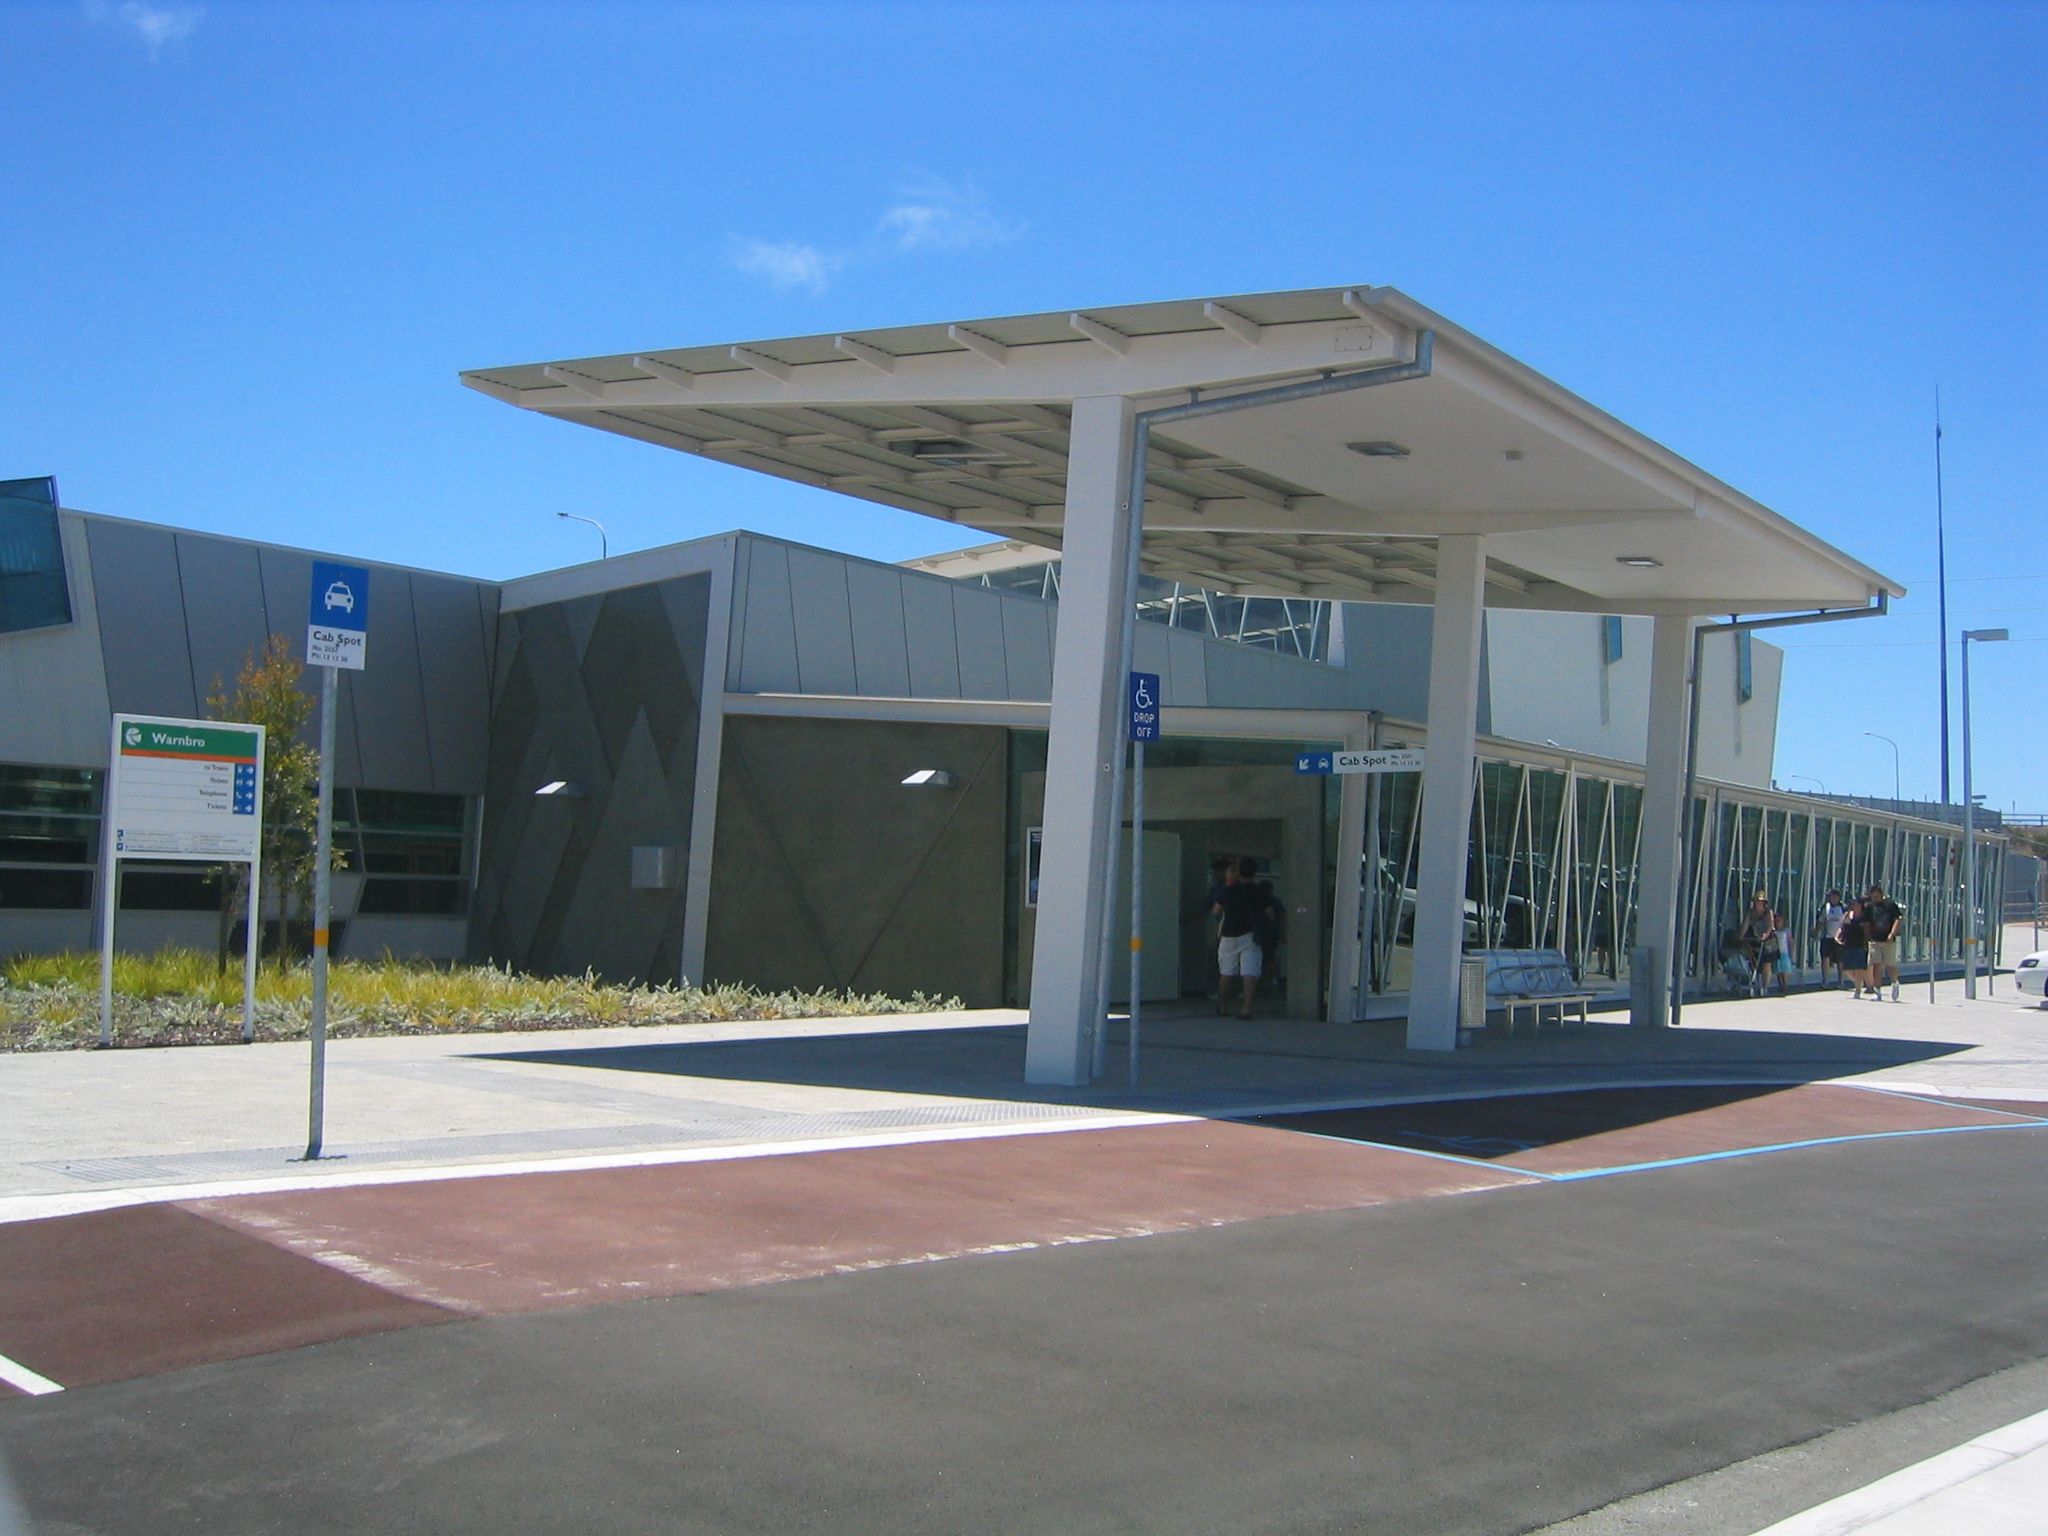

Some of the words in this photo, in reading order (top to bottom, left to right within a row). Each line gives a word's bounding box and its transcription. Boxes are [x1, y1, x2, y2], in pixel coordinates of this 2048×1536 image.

[313, 630, 334, 642] Cab
[337, 633, 361, 646] Spot
[1133, 711, 1155, 723] DROP
[1136, 726, 1152, 738] OFF
[152, 732, 206, 748] Warnbro
[1340, 756, 1360, 766] Cab
[1362, 755, 1387, 768] Spot
